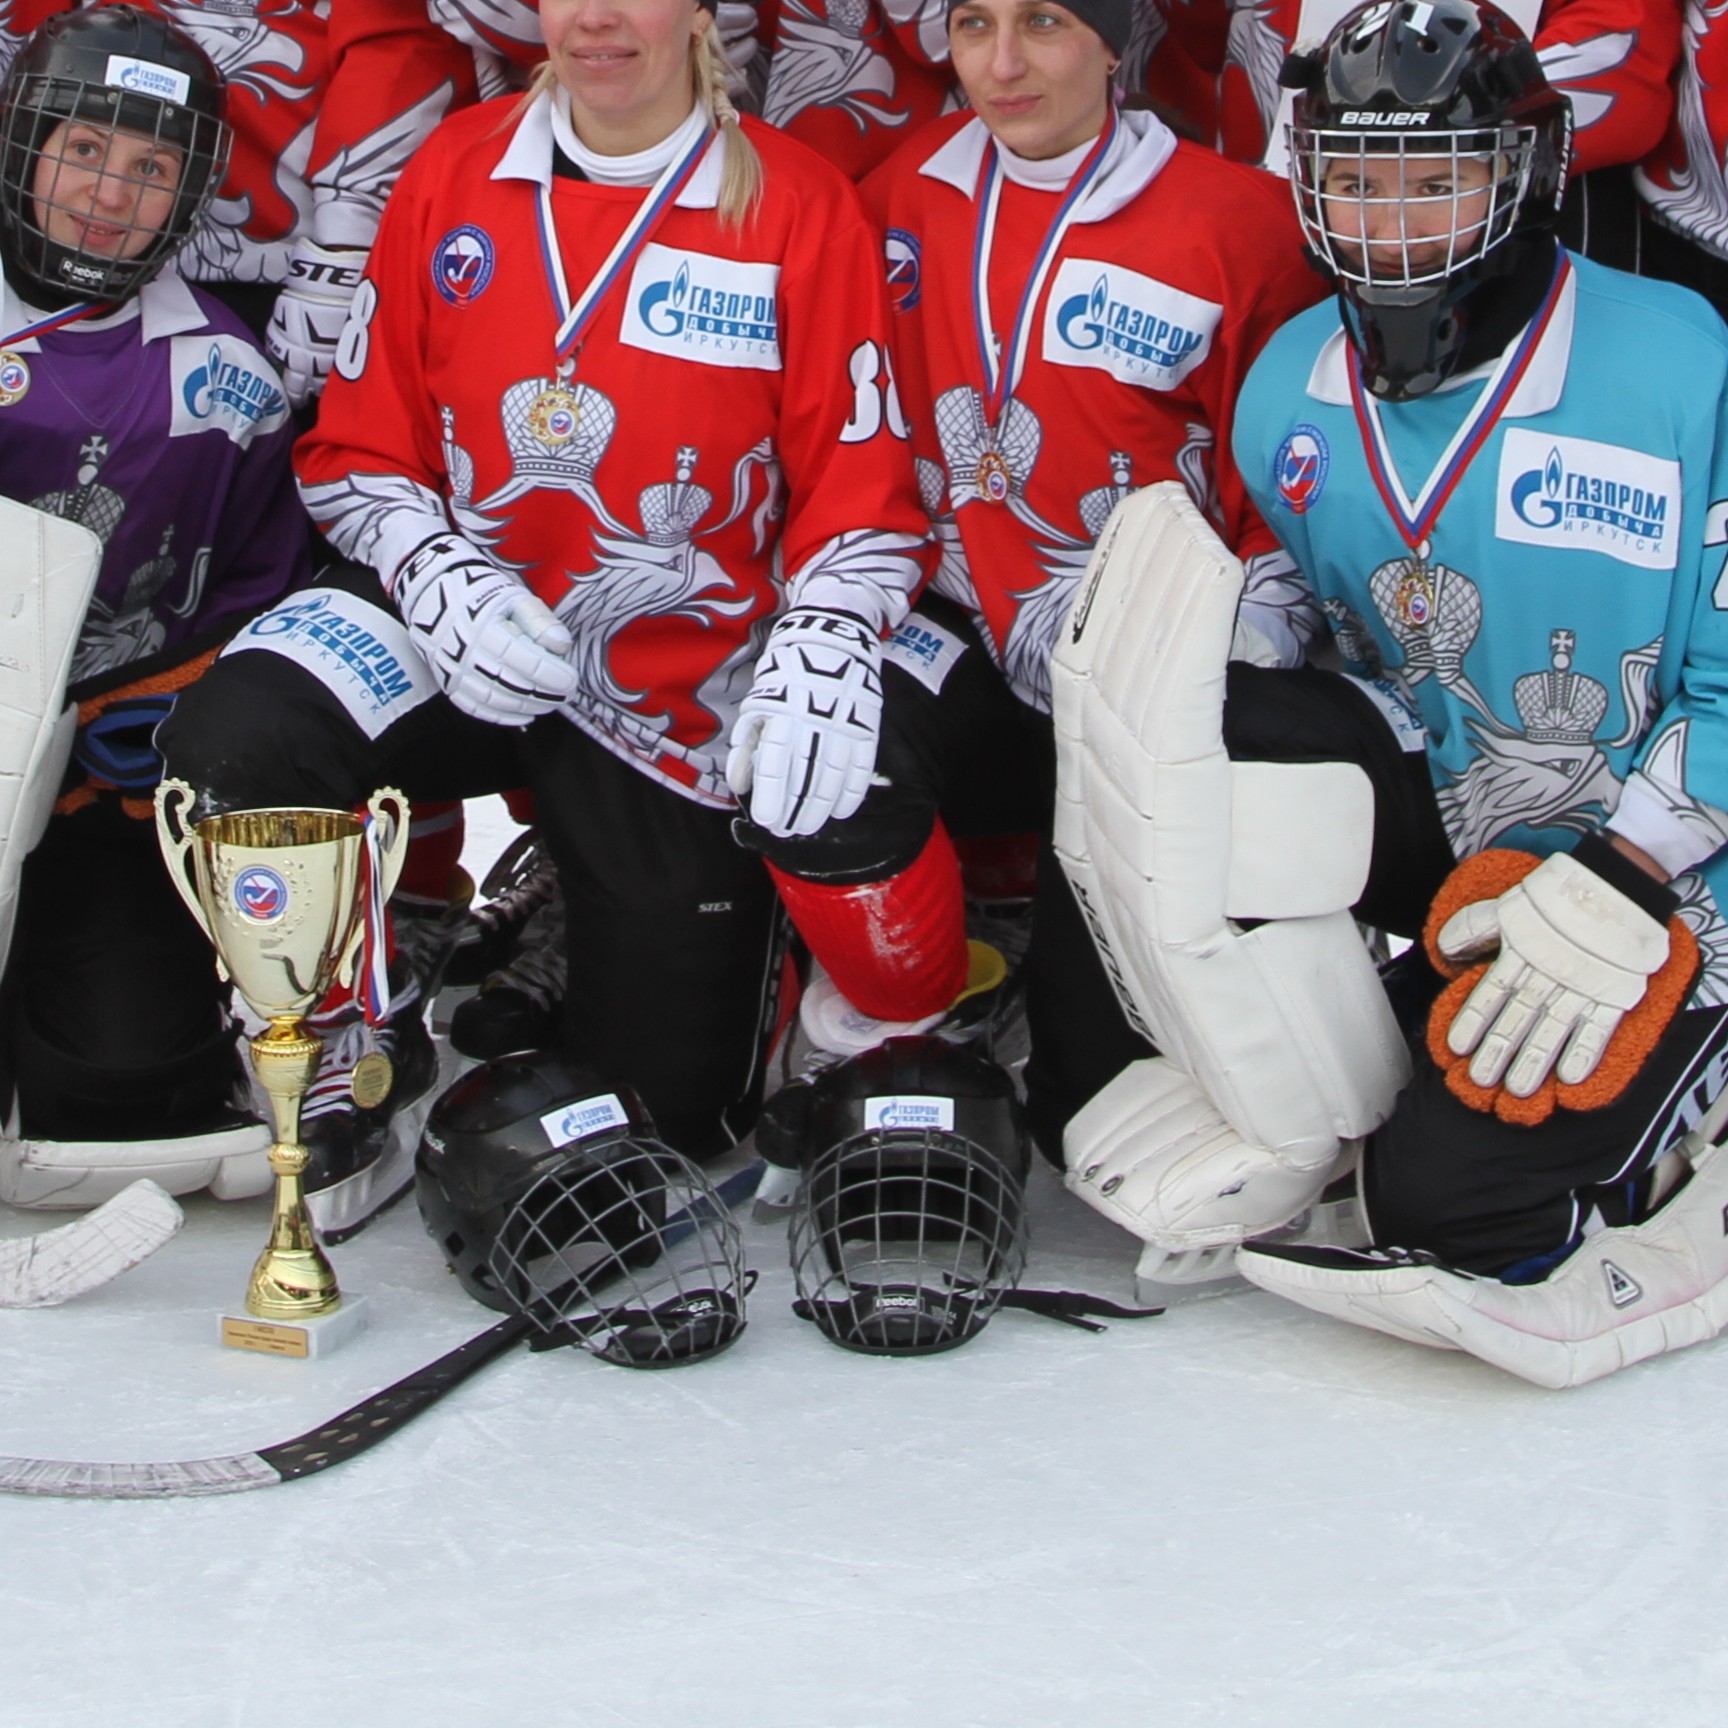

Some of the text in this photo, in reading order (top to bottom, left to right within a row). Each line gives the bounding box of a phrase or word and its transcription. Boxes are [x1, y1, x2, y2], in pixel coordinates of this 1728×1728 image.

[1340, 111, 1432, 126] BAUER
[290, 259, 365, 288] STE
[1566, 472, 1668, 522] ГАЗПРОМ
[1562, 520, 1663, 555] ИРКУТСК
[1565, 502, 1663, 539] ДОБЫЧА
[394, 538, 460, 605] TEX
[284, 631, 382, 717] ИРКУТСК
[296, 620, 391, 706] ДОБЫЧА
[313, 607, 414, 701] ГАЗПРОМ
[698, 901, 734, 913] STEX
